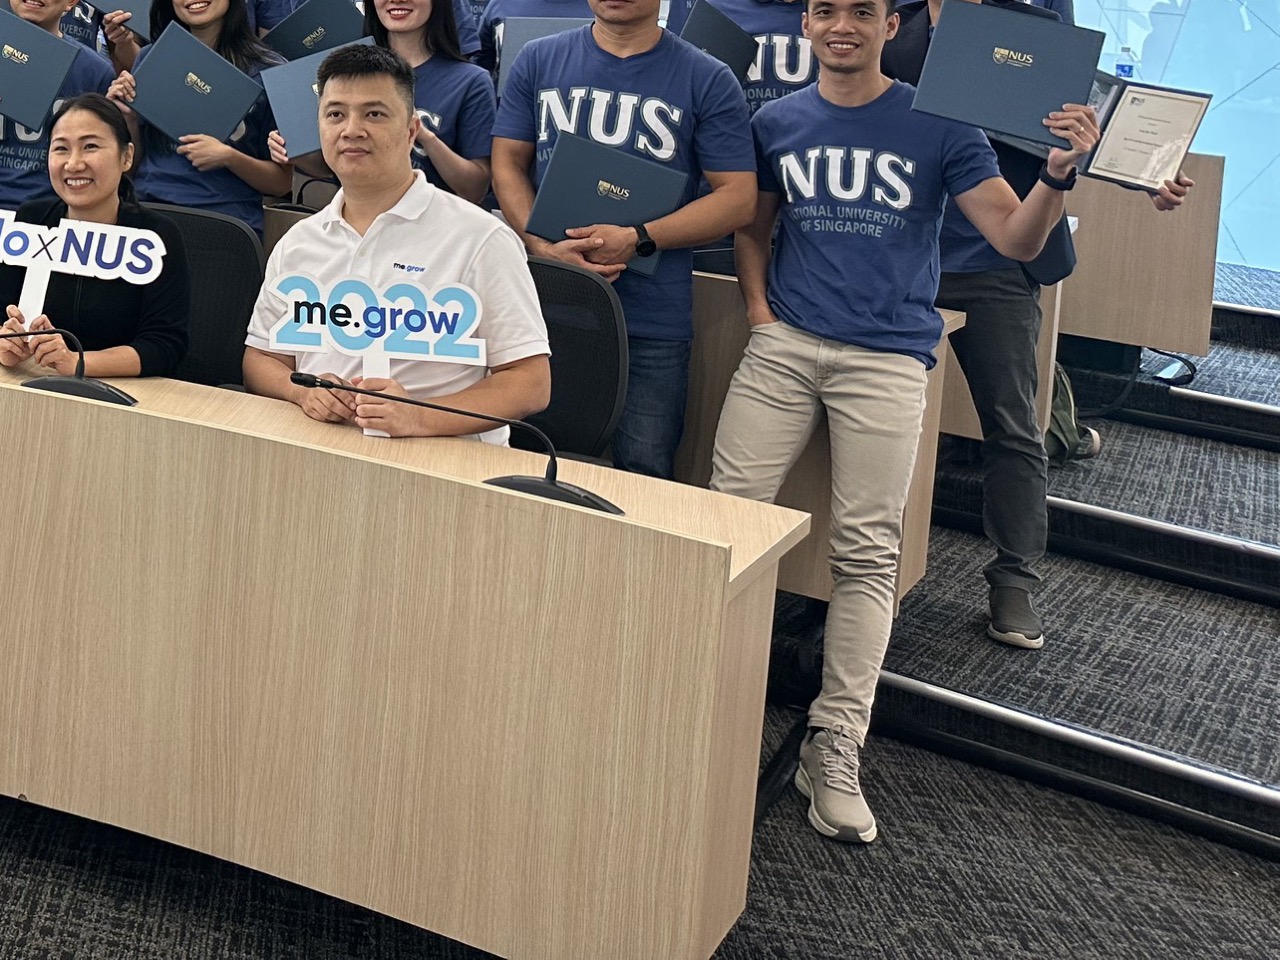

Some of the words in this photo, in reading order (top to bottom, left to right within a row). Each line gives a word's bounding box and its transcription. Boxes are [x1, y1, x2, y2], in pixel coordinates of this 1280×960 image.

[12, 45, 29, 62] NUS
[1008, 50, 1034, 64] NUS
[195, 77, 211, 94] NUS
[538, 88, 682, 160] NUS
[780, 145, 915, 210] NUS
[609, 184, 630, 198] NUS
[800, 219, 811, 232] OF
[814, 220, 884, 238] SINGAPORE
[837, 206, 907, 230] UNIVERSITY
[60, 228, 155, 275] NUS
[393, 262, 426, 273] me.grow
[276, 275, 480, 359] 2022
[293, 300, 460, 339] me.grow
